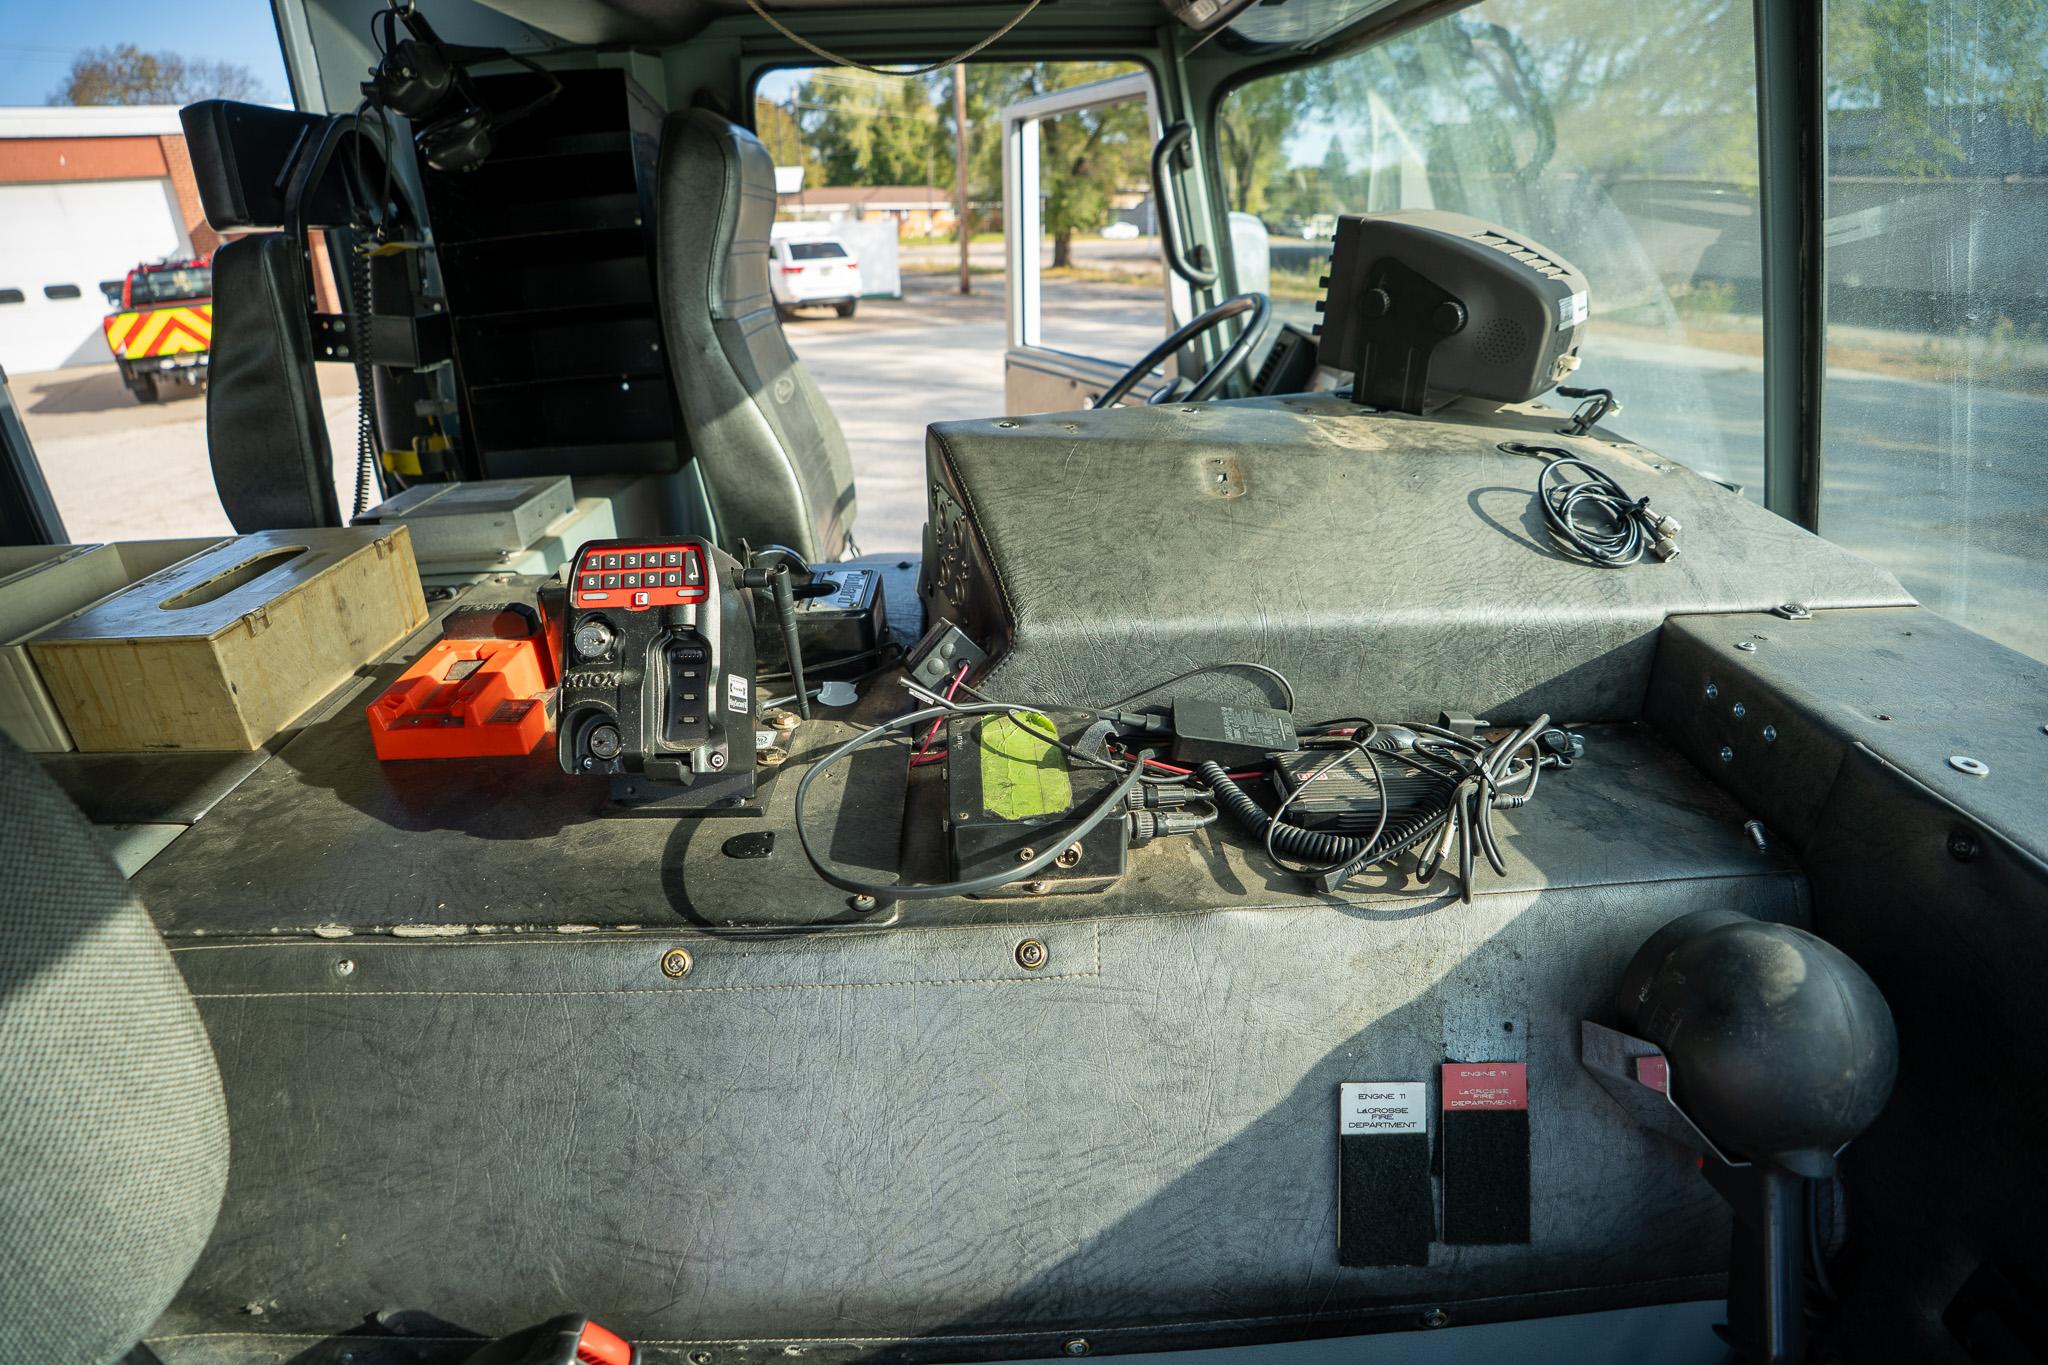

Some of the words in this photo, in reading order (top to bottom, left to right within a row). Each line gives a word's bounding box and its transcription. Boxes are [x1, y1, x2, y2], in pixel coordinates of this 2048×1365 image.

[591, 558, 598, 566] 1
[609, 557, 616, 566] 2
[629, 556, 636, 565] 3
[649, 556, 656, 564] 4
[669, 555, 676, 563] 5
[588, 577, 595, 586] 6
[608, 576, 615, 585] 7
[628, 576, 635, 584] 8
[648, 575, 655, 583] 9
[669, 574, 676, 583] 0
[562, 672, 621, 688] KNOX
[1348, 1121, 1417, 1129] DEPARTMENT
